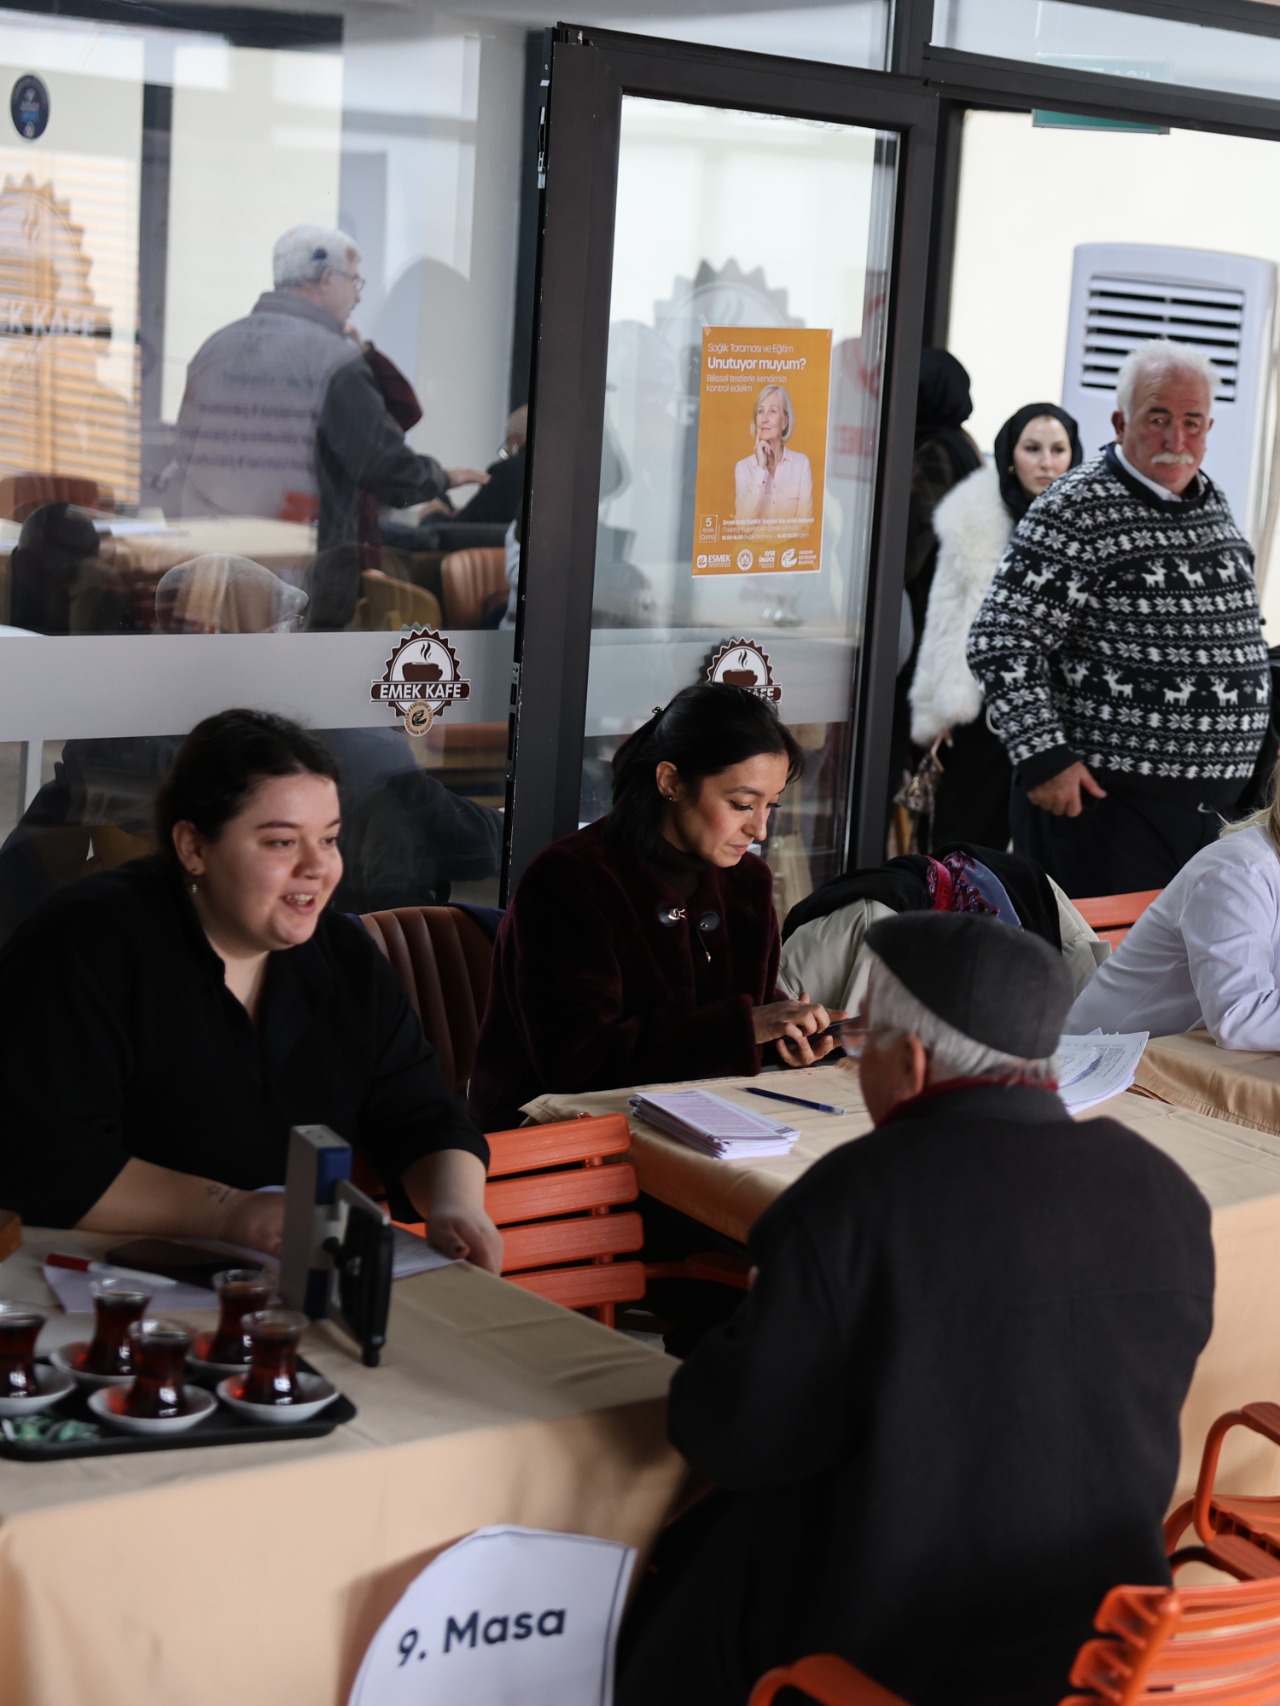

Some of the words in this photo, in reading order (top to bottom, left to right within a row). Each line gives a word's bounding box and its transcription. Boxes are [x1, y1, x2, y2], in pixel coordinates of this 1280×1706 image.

[762, 345, 772, 353] ve
[707, 356, 757, 372] Unutuyor
[759, 357, 807, 372] muyum?
[705, 517, 712, 527] 5
[708, 554, 731, 563] ESMEK
[380, 684, 422, 699] EMEK
[425, 683, 462, 698] KAFE
[397, 1627, 427, 1668] 9.
[443, 1608, 567, 1654] Masa
